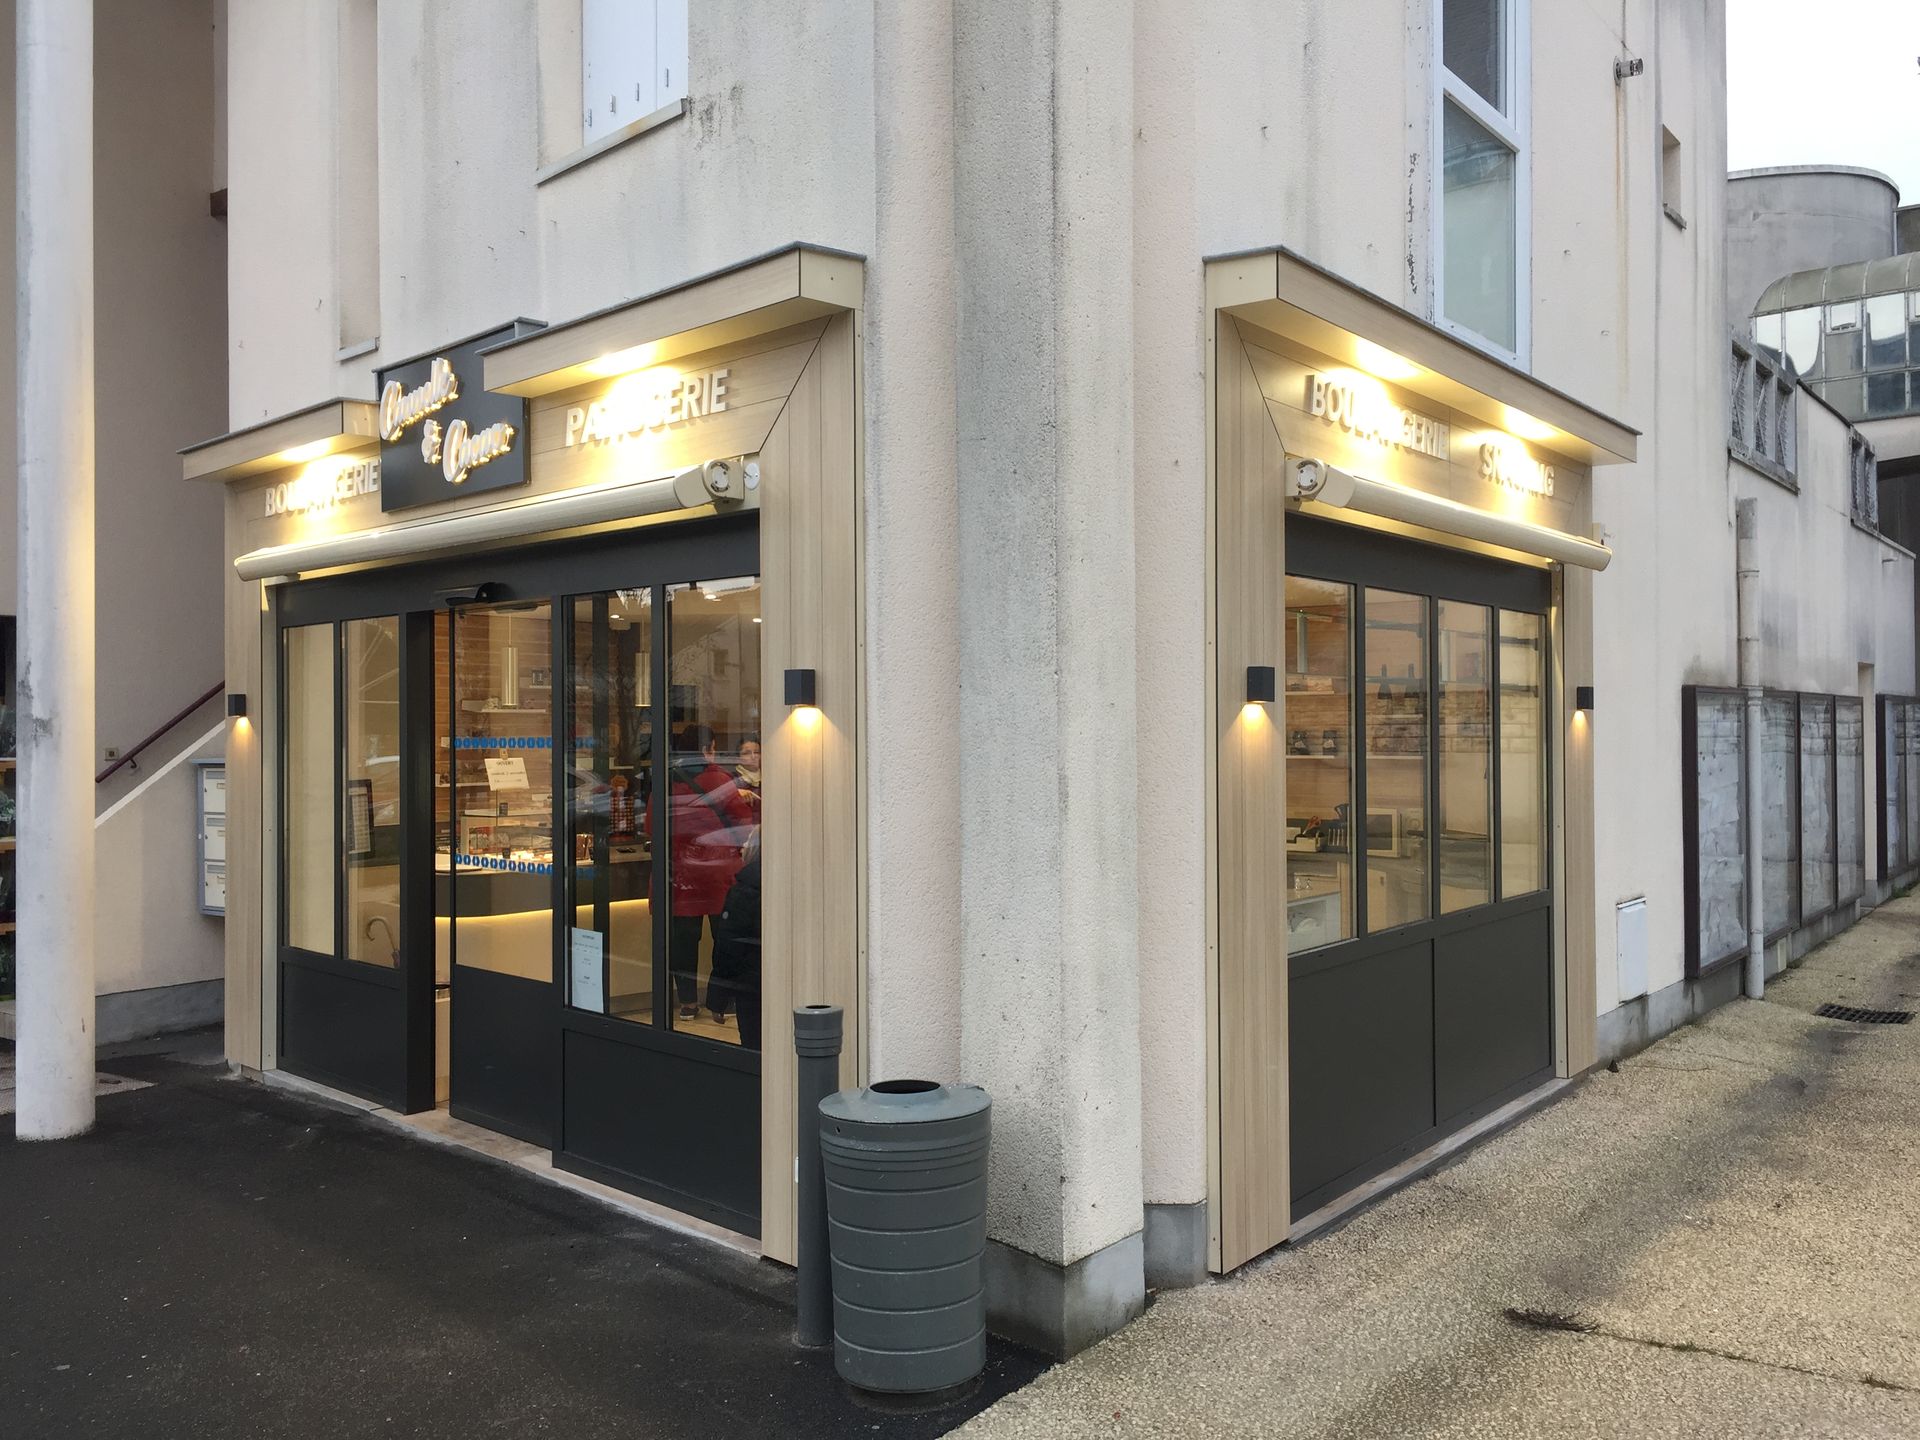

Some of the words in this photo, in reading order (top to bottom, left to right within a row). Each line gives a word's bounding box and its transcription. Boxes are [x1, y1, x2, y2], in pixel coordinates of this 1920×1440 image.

[565, 368, 728, 446] PAERIE
[1311, 373, 1449, 460] BOUGERIE
[421, 419, 442, 464] &
[442, 419, 514, 483] Cacao
[265, 459, 380, 518] BOUGERIE
